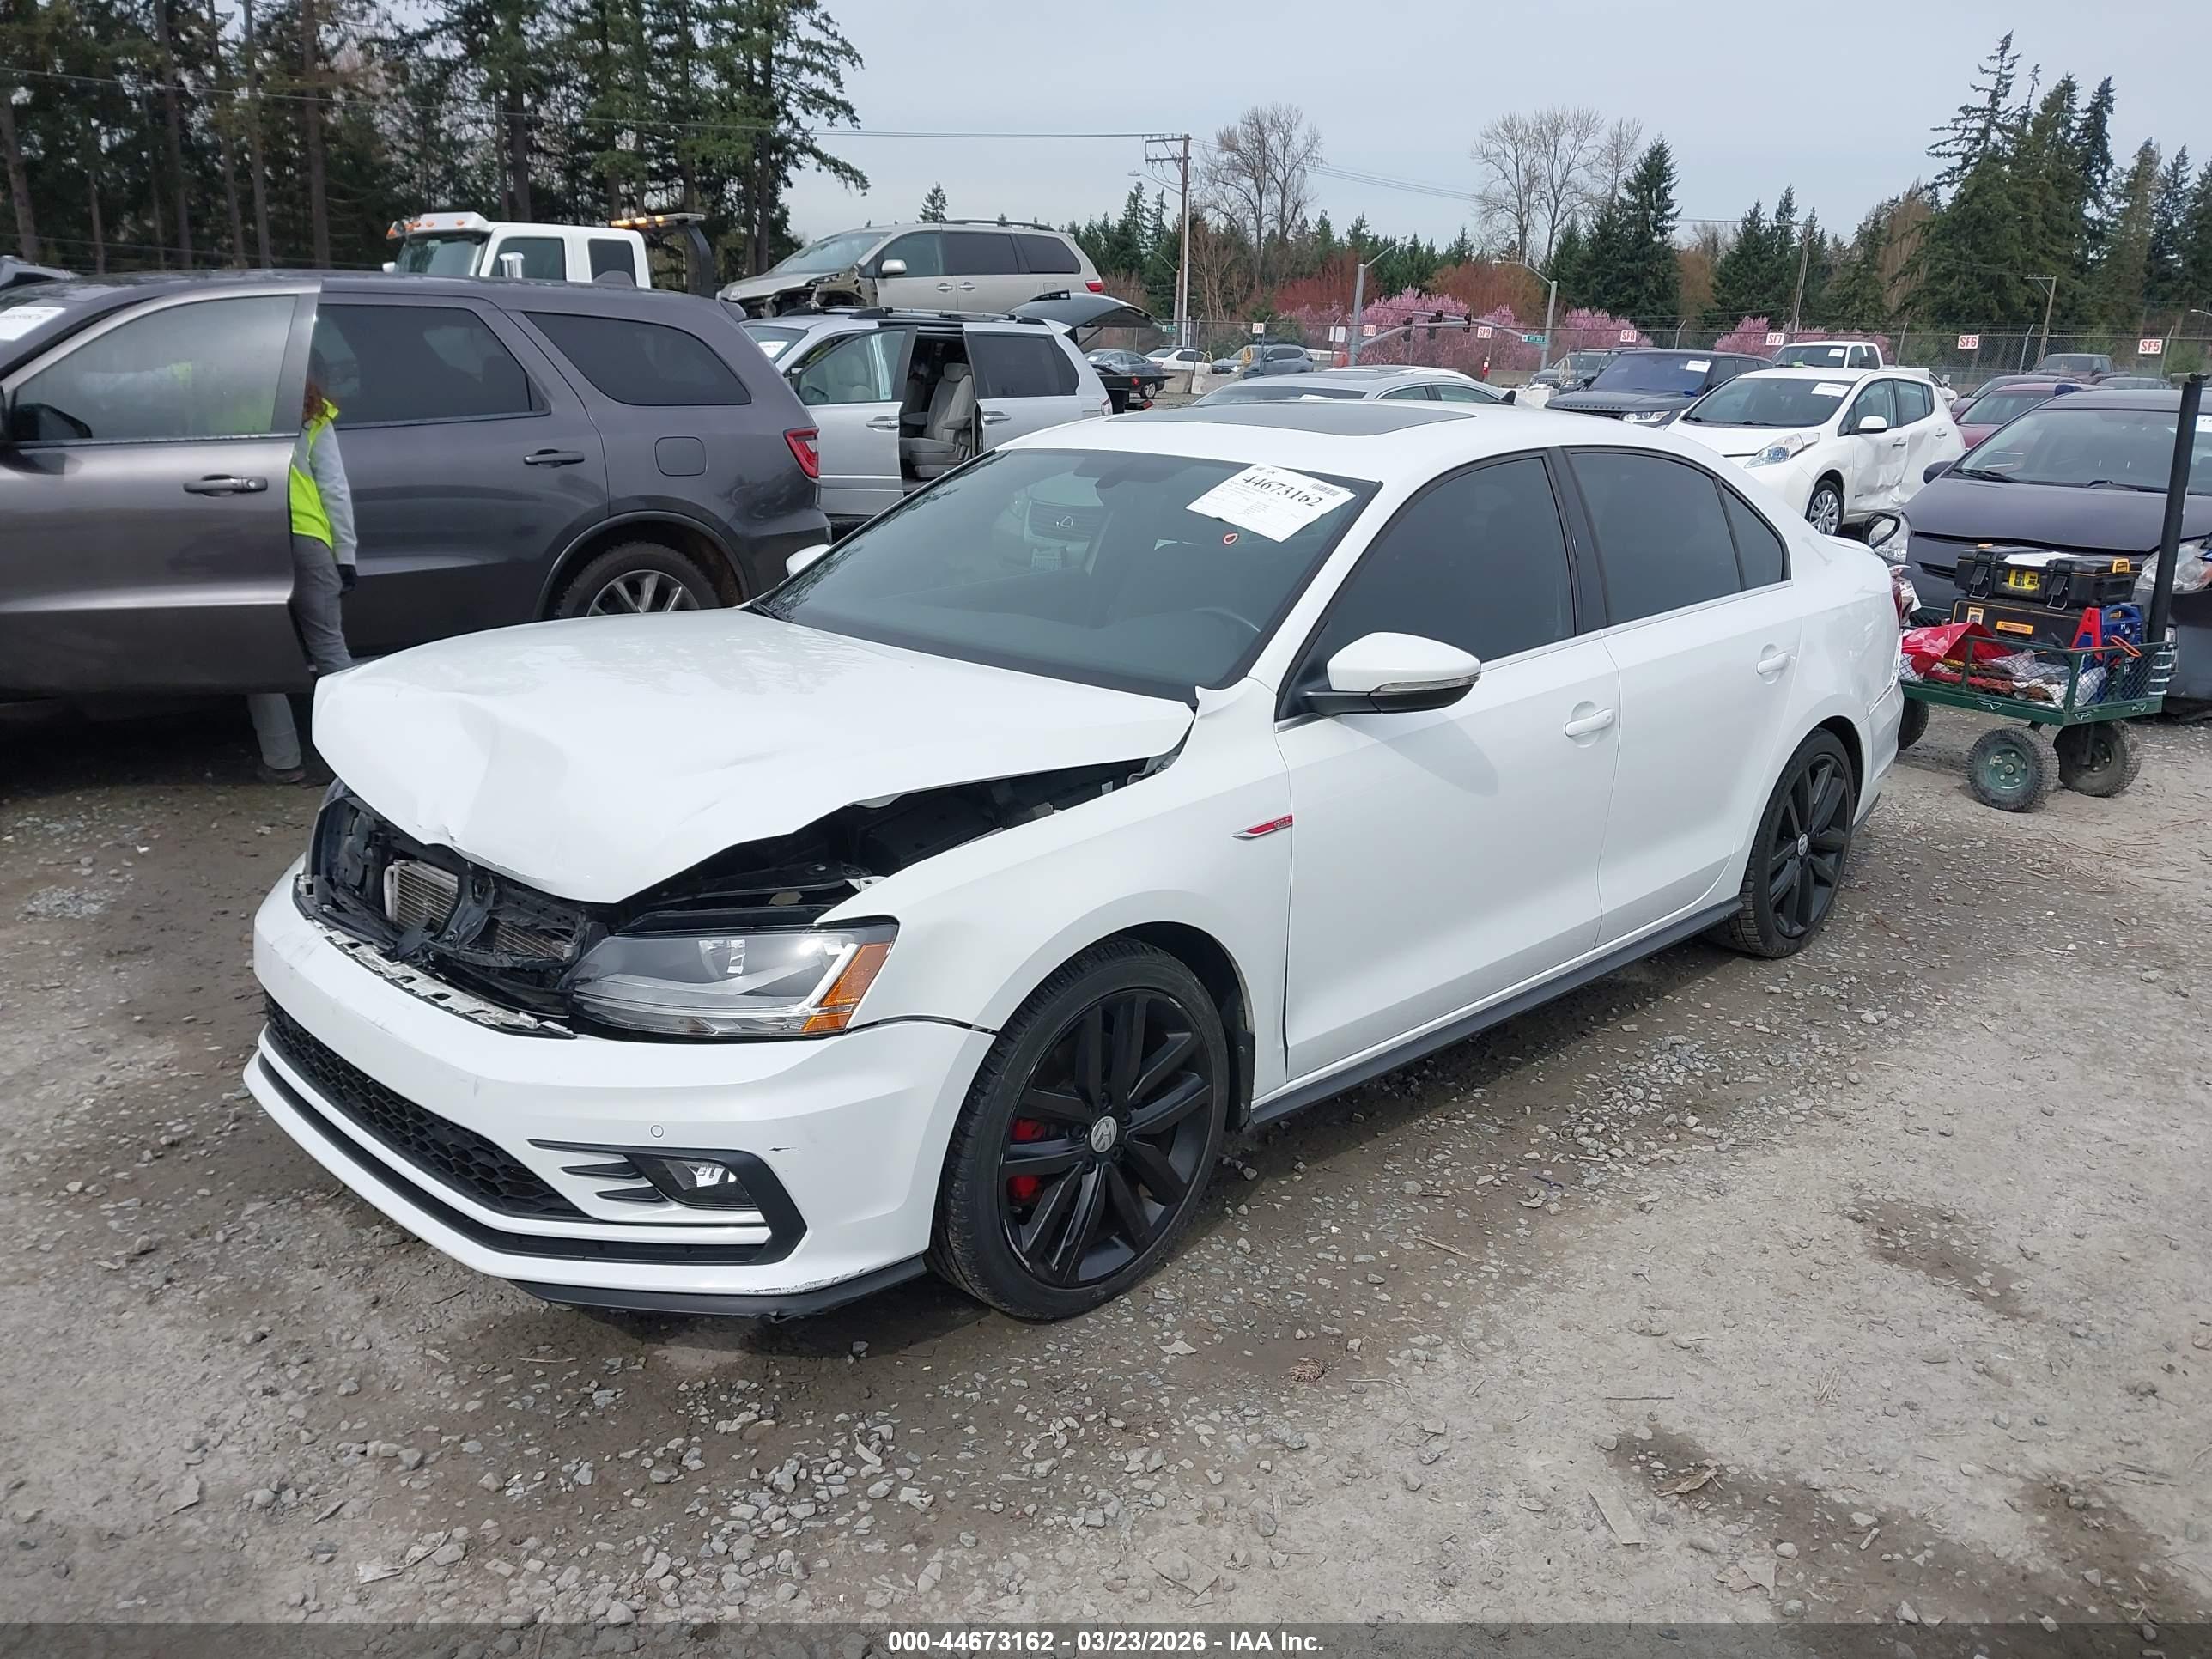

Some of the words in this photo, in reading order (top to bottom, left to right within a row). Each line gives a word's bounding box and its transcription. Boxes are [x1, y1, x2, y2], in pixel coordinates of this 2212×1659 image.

[1478, 328, 1491, 337] SF9
[1768, 334, 1783, 344] SF7
[1960, 336, 1977, 348] SF6
[2141, 340, 2160, 352] SF5
[1243, 475, 1323, 507] 44673162
